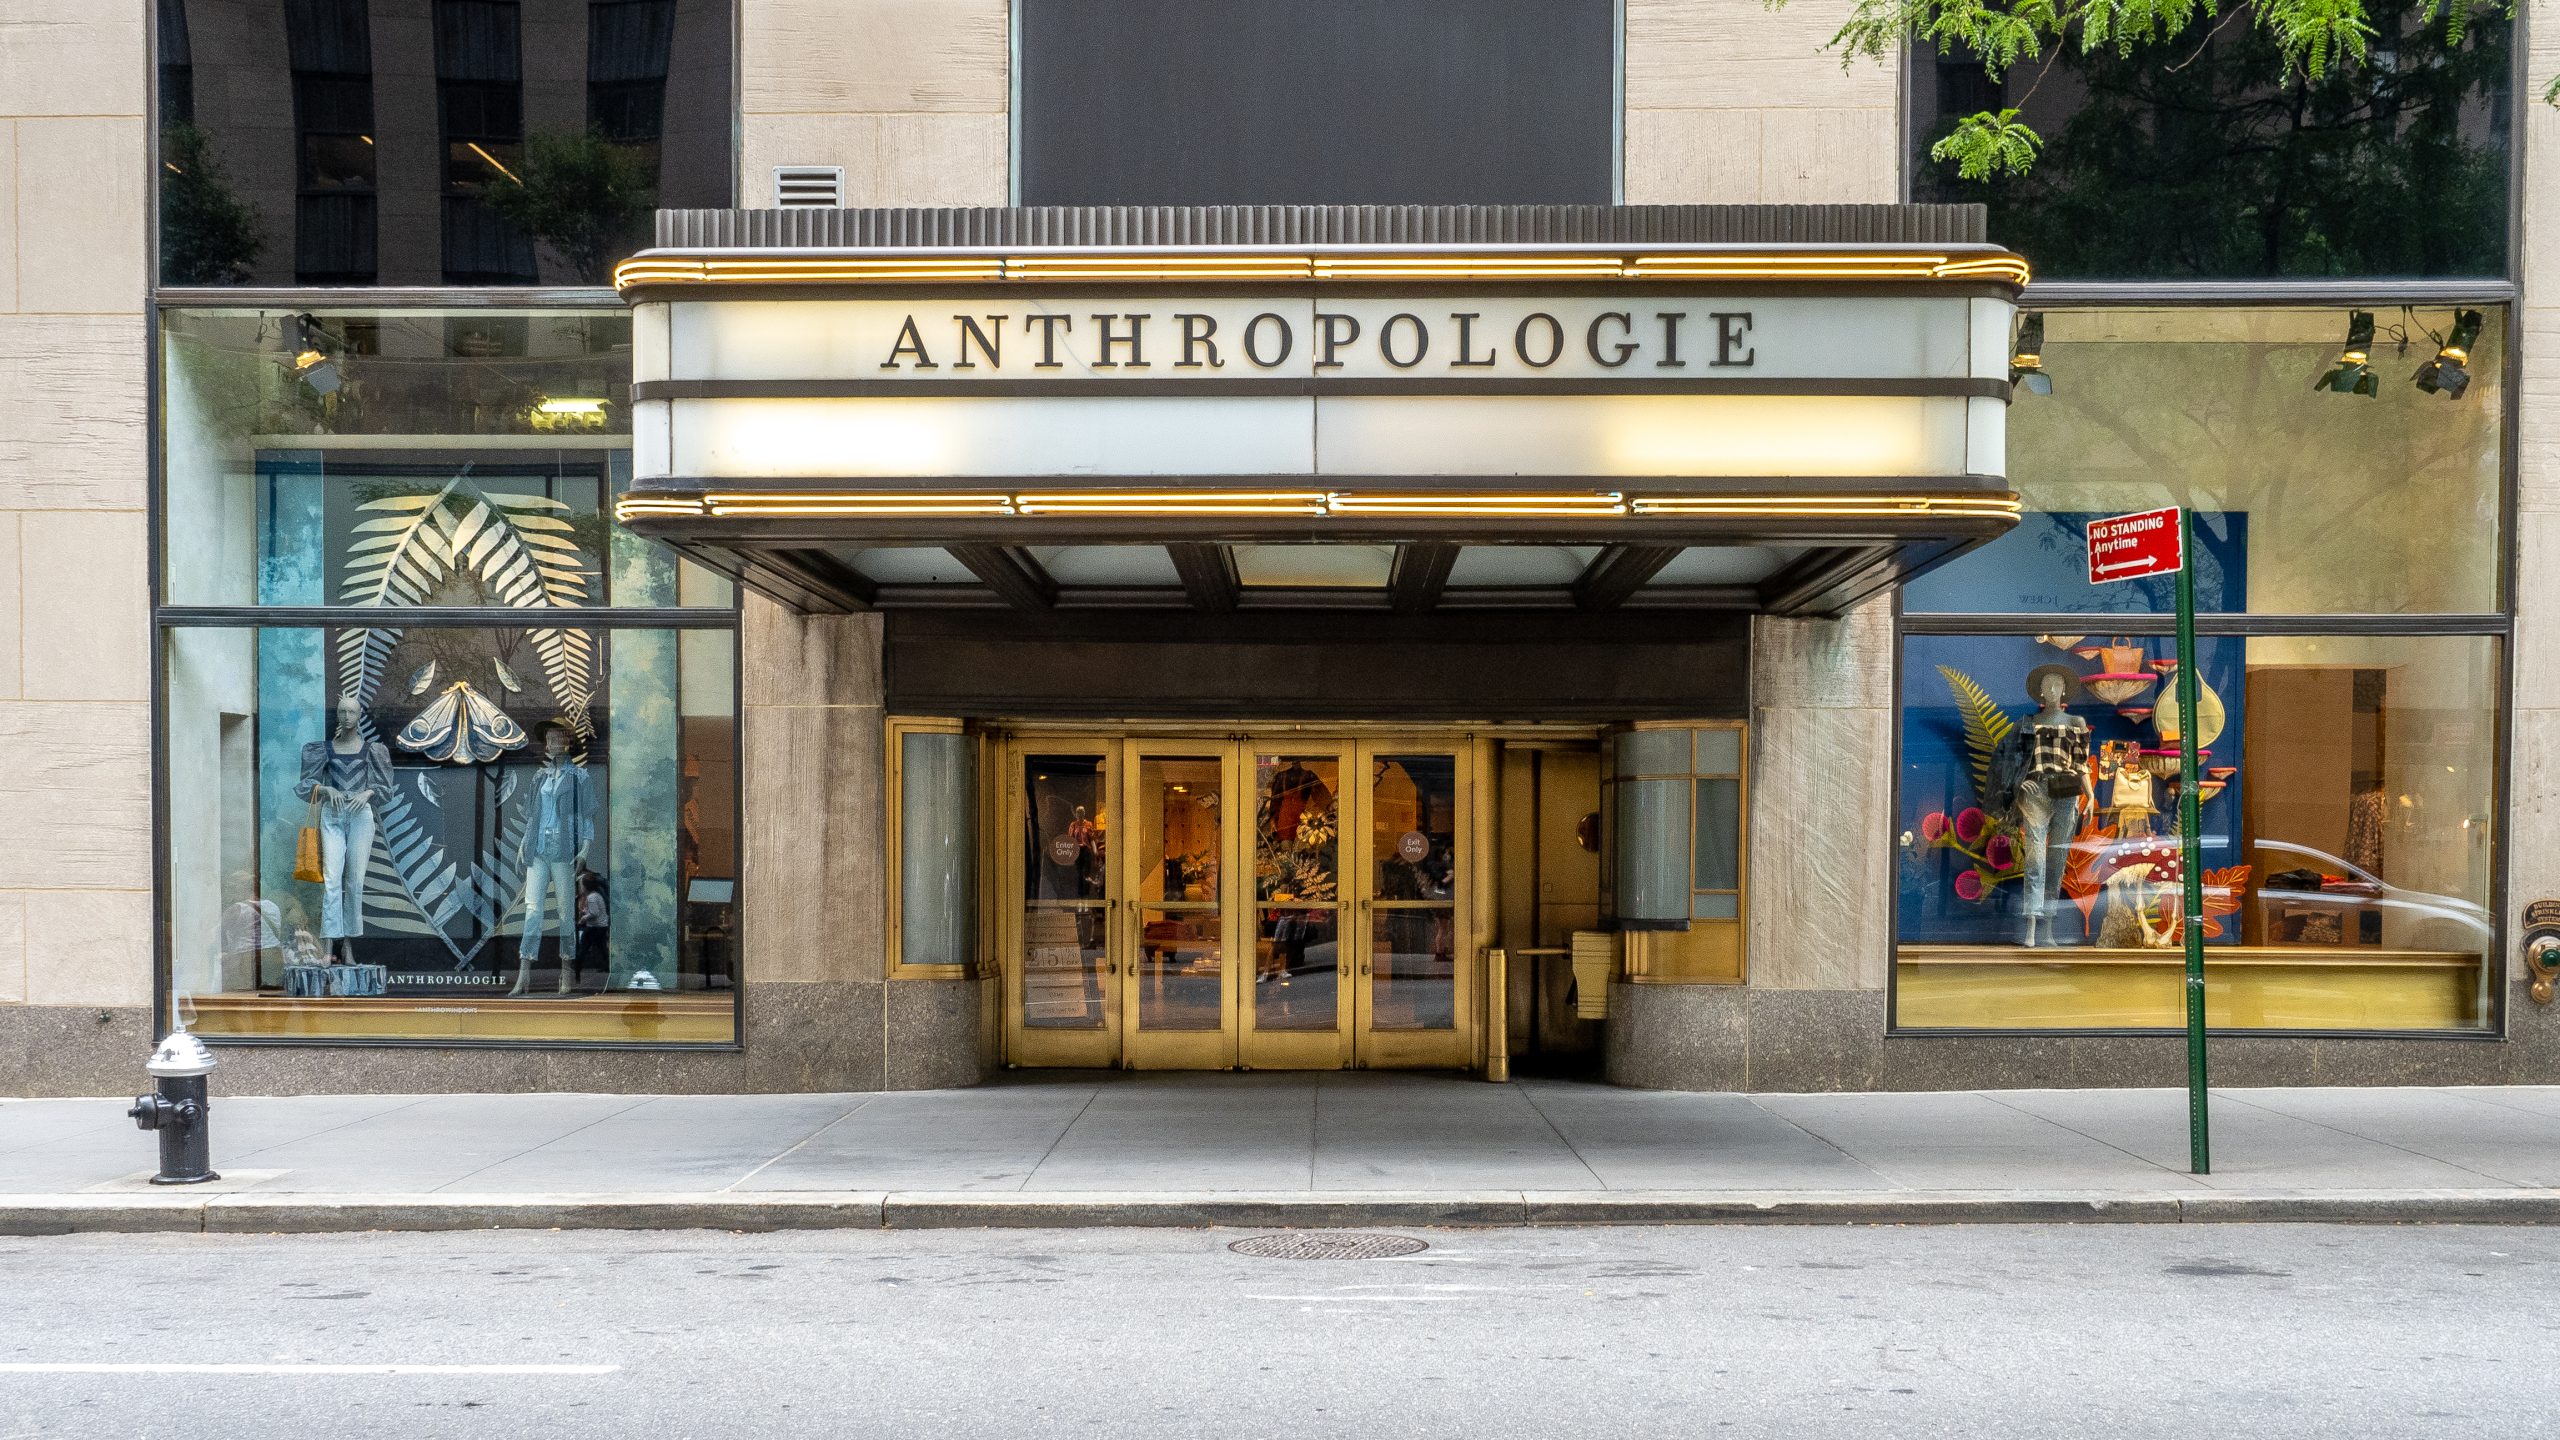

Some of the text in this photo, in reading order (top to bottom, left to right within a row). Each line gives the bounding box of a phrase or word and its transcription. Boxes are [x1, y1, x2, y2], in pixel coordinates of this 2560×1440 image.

[880, 311, 1754, 368] ANTHROPOLOGIE
[2093, 516, 2164, 540] NO STANDING
[2094, 537, 2138, 554] Anytime
[1055, 841, 1074, 849] Enter
[1056, 849, 1074, 858] Only
[387, 975, 507, 985] ANTHROPOLOGIE
